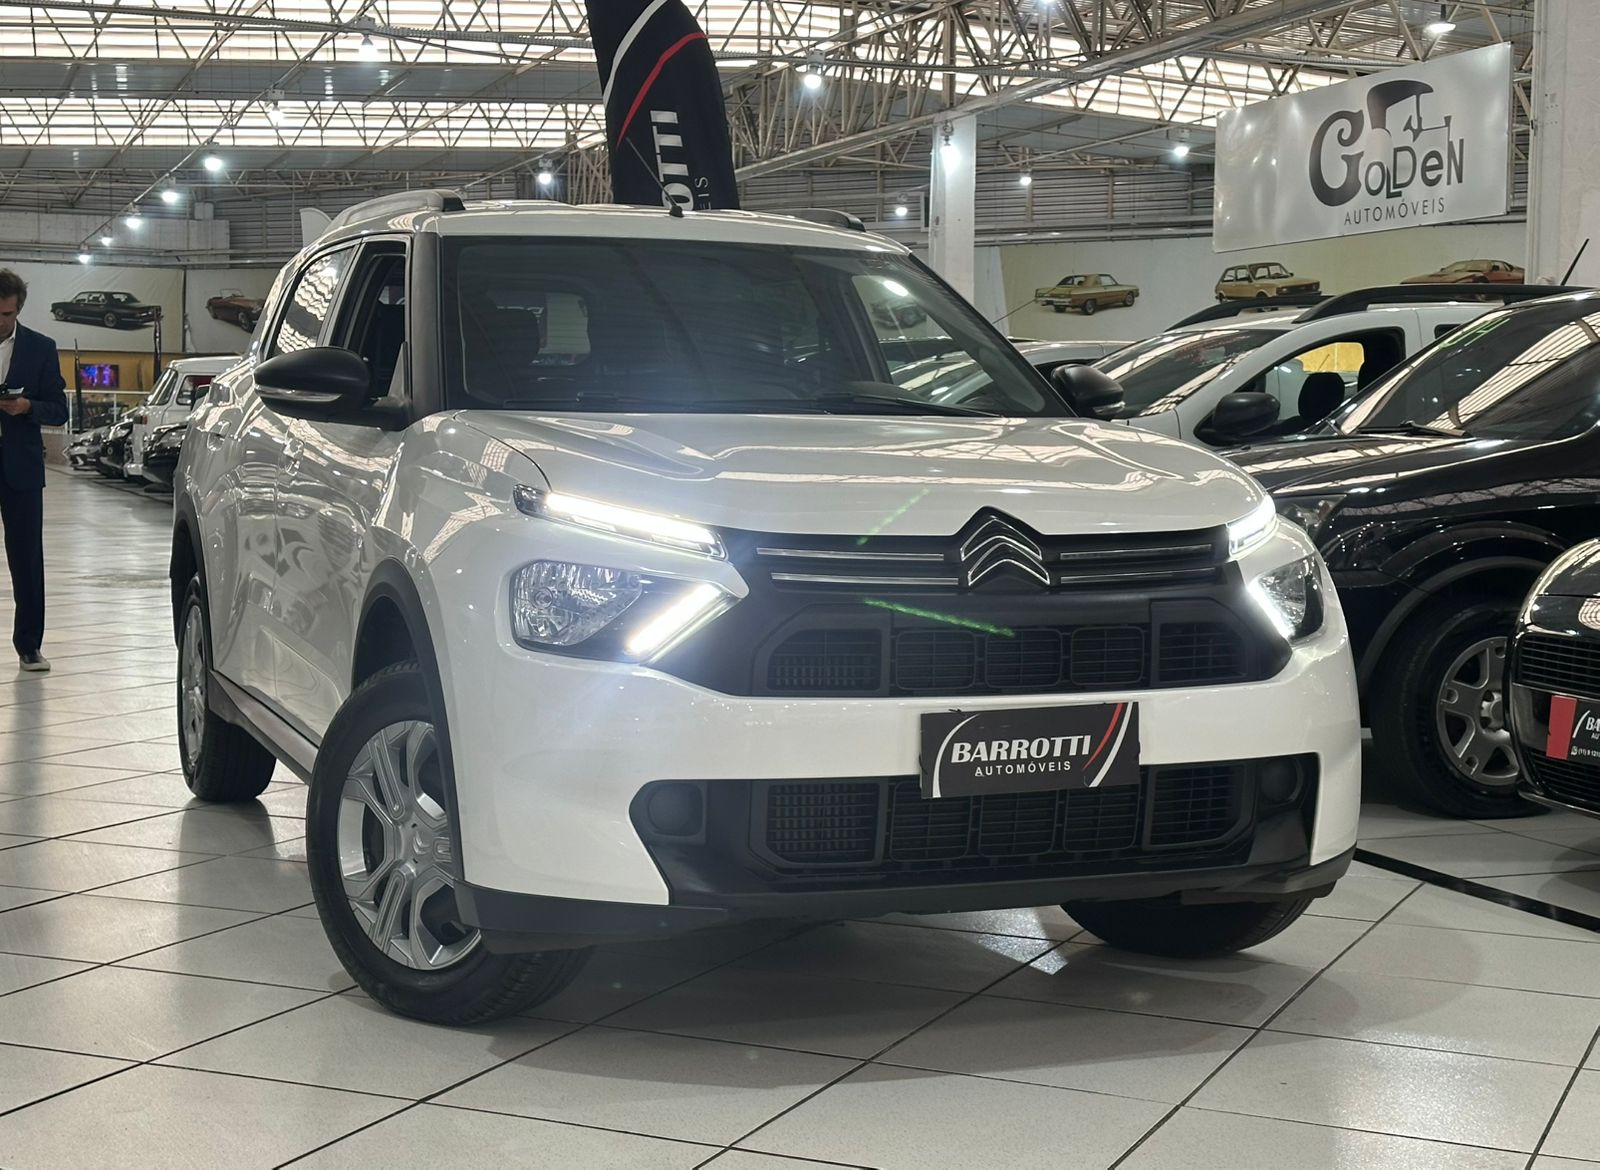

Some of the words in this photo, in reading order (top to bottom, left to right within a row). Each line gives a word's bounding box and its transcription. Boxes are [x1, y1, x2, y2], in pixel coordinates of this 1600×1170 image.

[1344, 197, 1445, 225] AUTOMÓVEIS
[951, 735, 1091, 763] BARROTTI
[975, 760, 1072, 777] AUTOMÓVEIS
